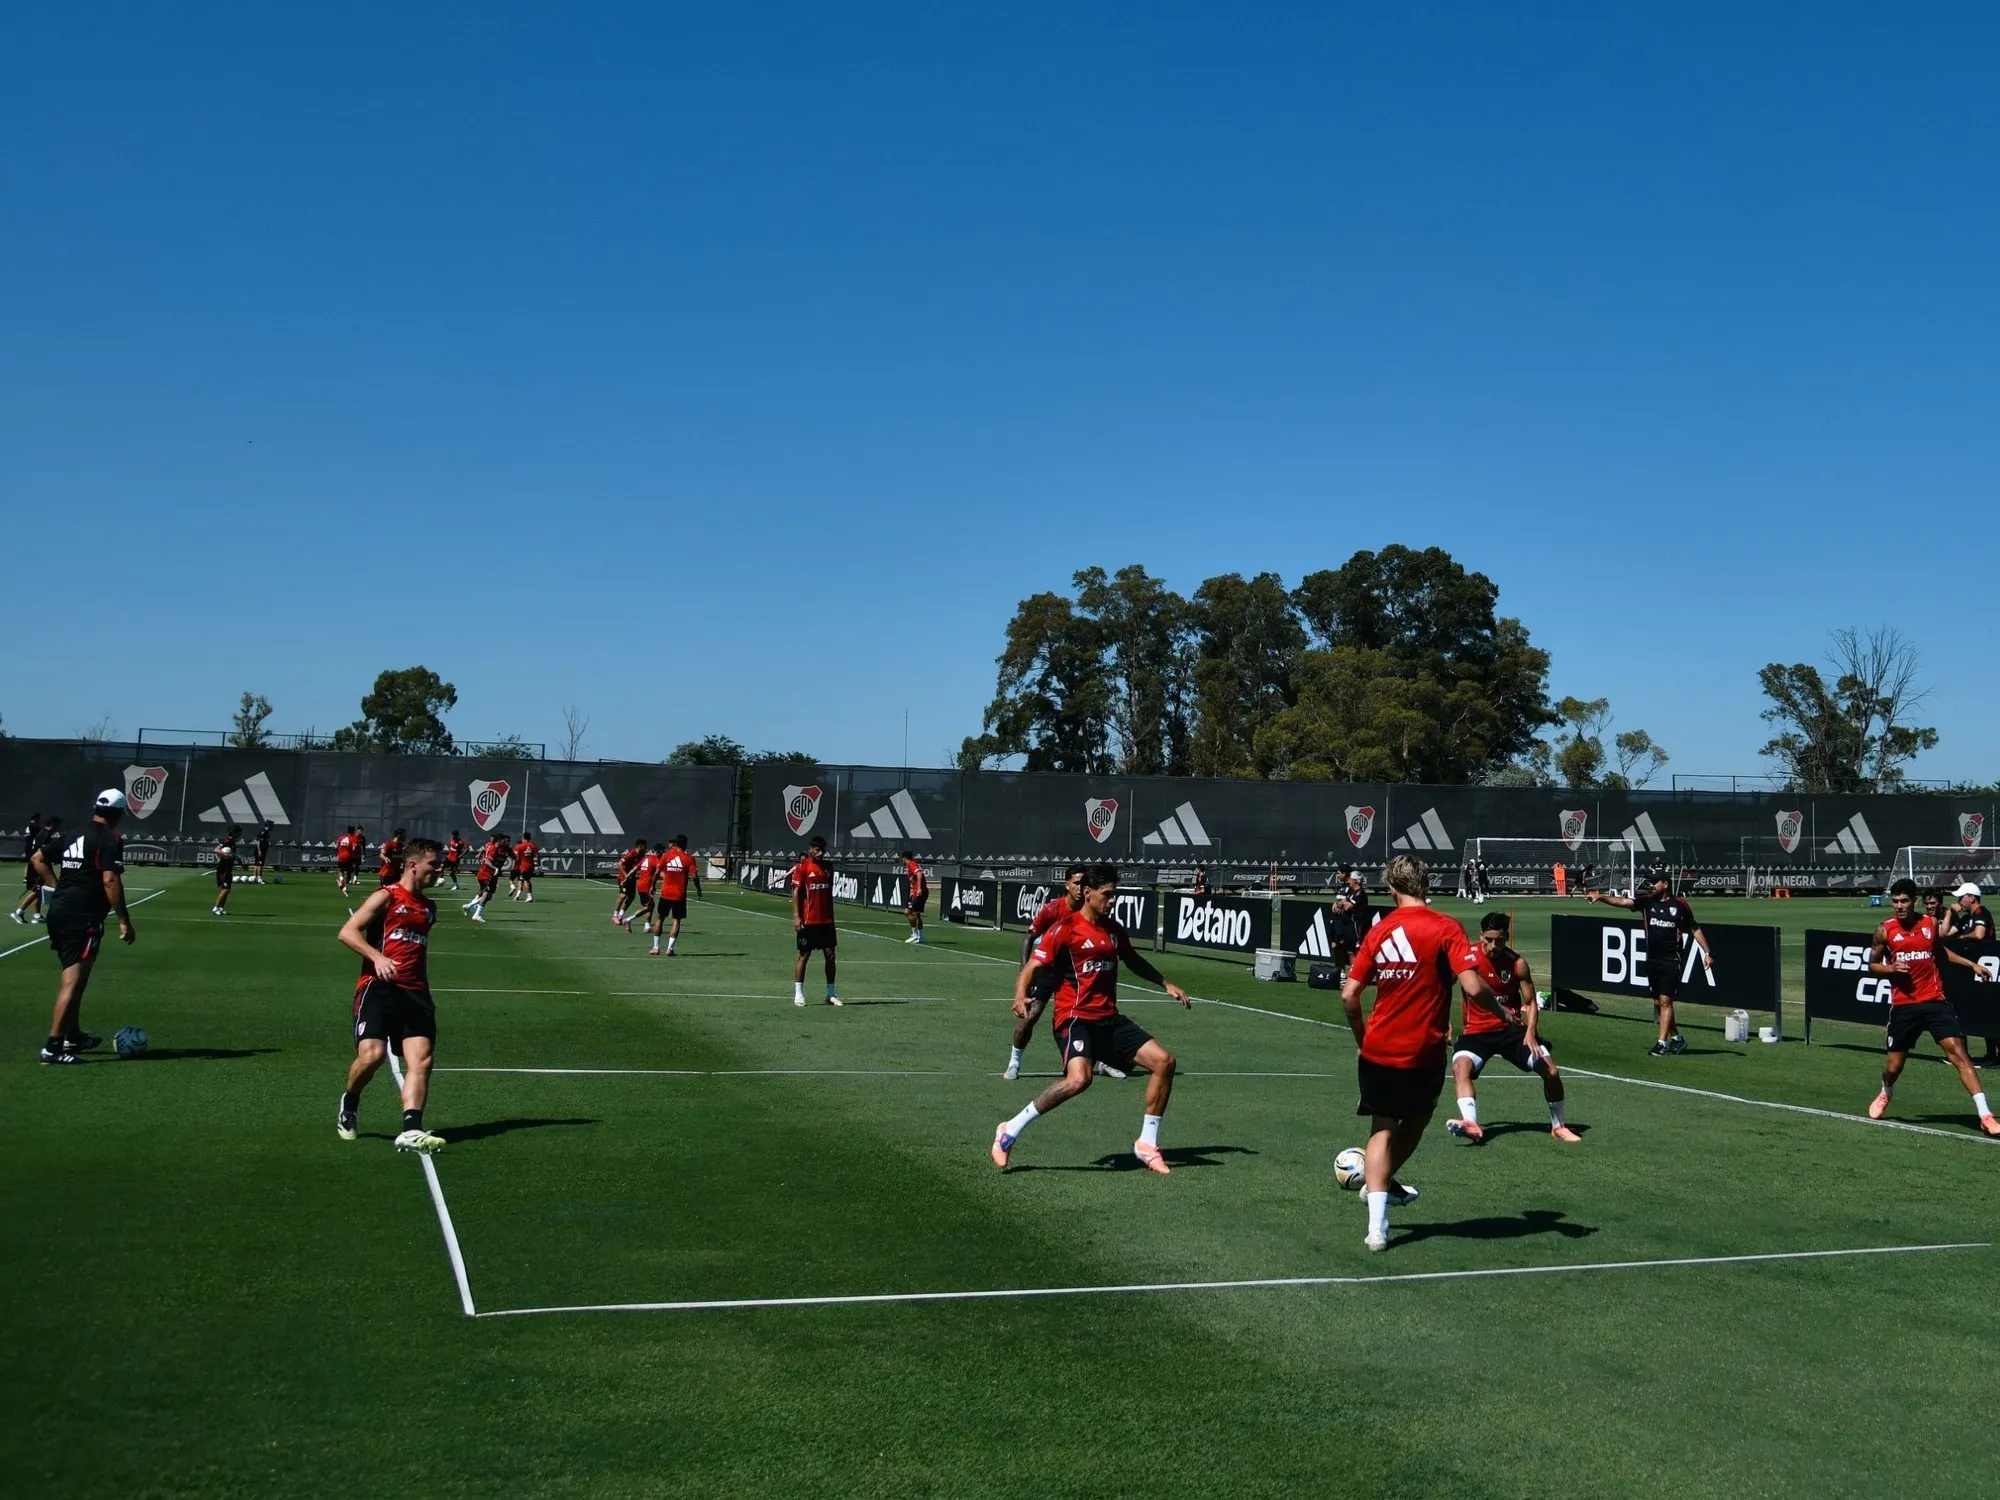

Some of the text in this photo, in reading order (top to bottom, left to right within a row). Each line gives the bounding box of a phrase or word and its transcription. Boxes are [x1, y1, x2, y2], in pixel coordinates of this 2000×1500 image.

[131, 775, 157, 800] CARP
[477, 790, 501, 814] CARP
[790, 795, 814, 818] CARP
[1091, 806, 1111, 828] CARP
[1350, 814, 1368, 835] CARP
[1565, 817, 1582, 837] CARP
[1780, 818, 1798, 839] CARP
[1963, 821, 1980, 841] CARP
[197, 853, 221, 863] BBV
[998, 867, 1033, 877] avalian
[1753, 876, 1781, 887] LOMA
[1783, 876, 1816, 887] NEGRA
[833, 871, 858, 899] Betano
[962, 885, 984, 906] avalian
[1177, 897, 1251, 947] Betano
[1650, 917, 1675, 928] Betano
